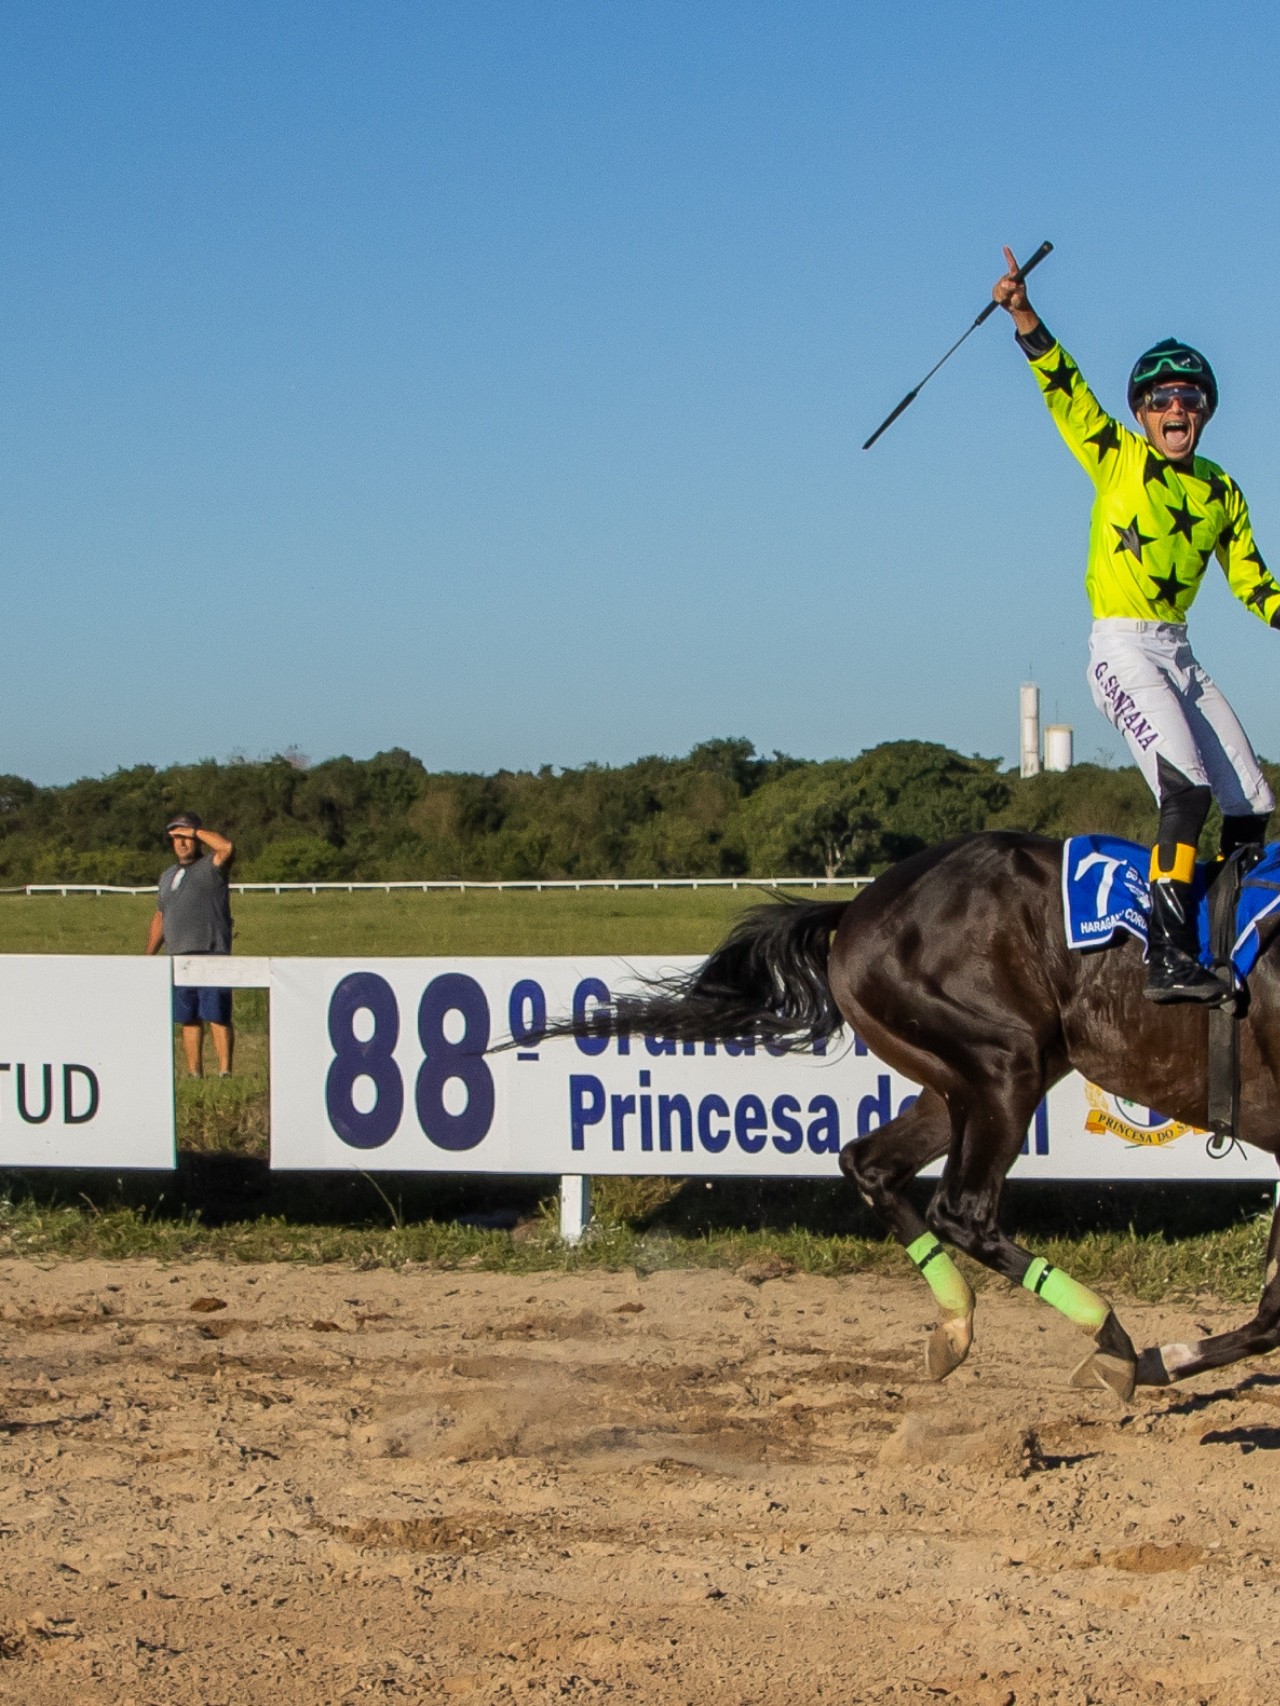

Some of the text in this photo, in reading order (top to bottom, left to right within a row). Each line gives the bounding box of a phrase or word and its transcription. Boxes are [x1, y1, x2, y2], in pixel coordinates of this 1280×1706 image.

[1074, 852, 1122, 918] 7
[569, 1069, 918, 1154] Princesa d
[1098, 1113, 1153, 1143] PRINCESA
[1156, 1129, 1174, 1141] DO
